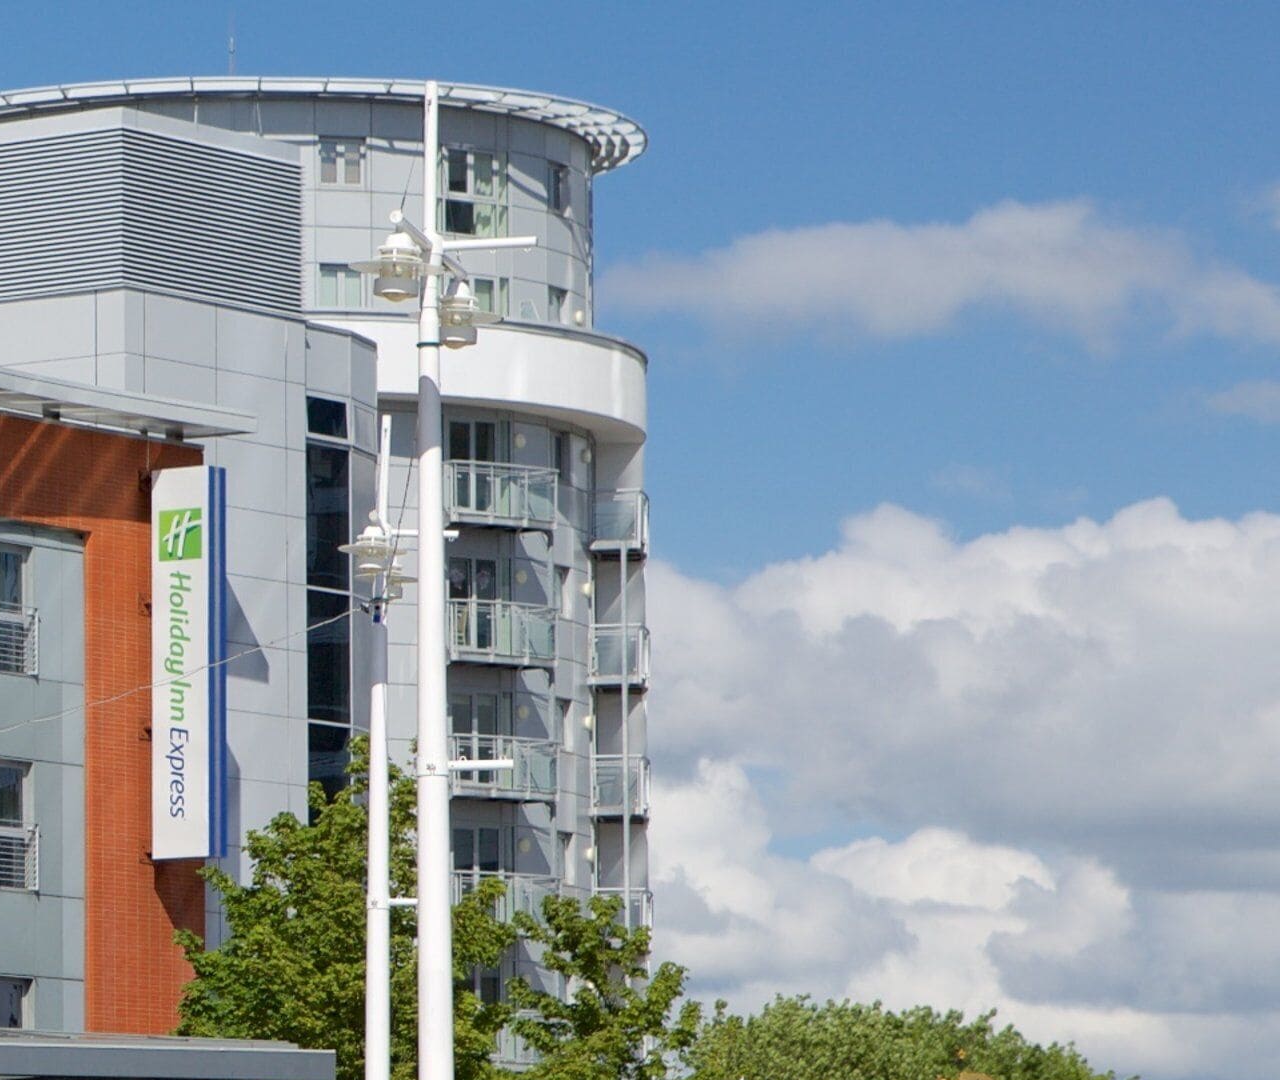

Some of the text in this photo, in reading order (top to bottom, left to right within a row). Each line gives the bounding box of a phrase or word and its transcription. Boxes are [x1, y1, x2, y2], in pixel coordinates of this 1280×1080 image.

[164, 571, 192, 818] Holiday Inn Express
